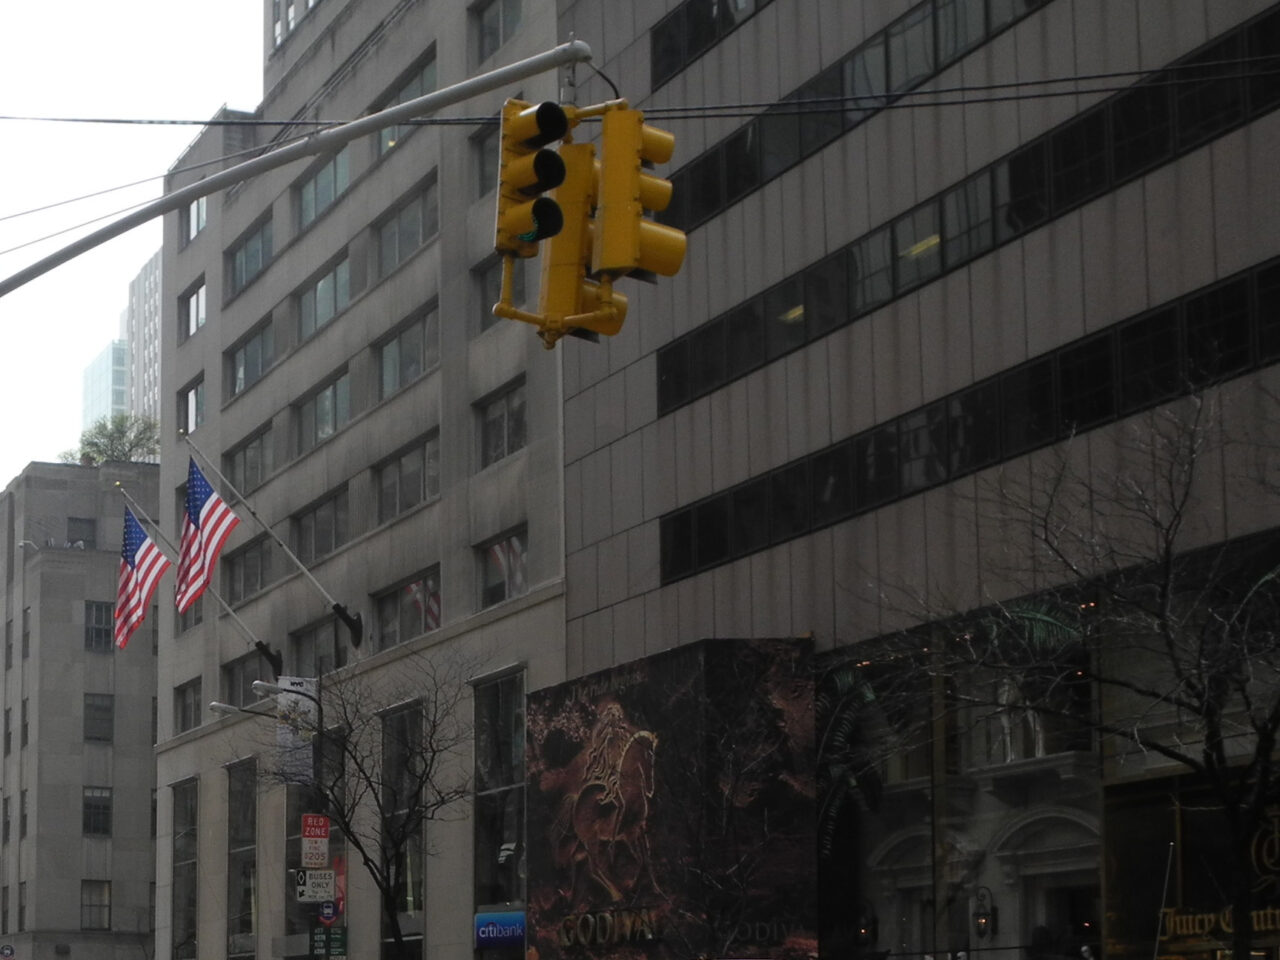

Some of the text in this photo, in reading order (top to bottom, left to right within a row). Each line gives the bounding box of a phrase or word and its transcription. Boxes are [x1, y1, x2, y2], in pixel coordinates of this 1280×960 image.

[307, 817, 324, 825] RED
[305, 827, 326, 836] ZONE
[479, 921, 524, 938] citibank
[560, 907, 654, 946] GODIVA
[1160, 907, 1216, 939] Juicy
